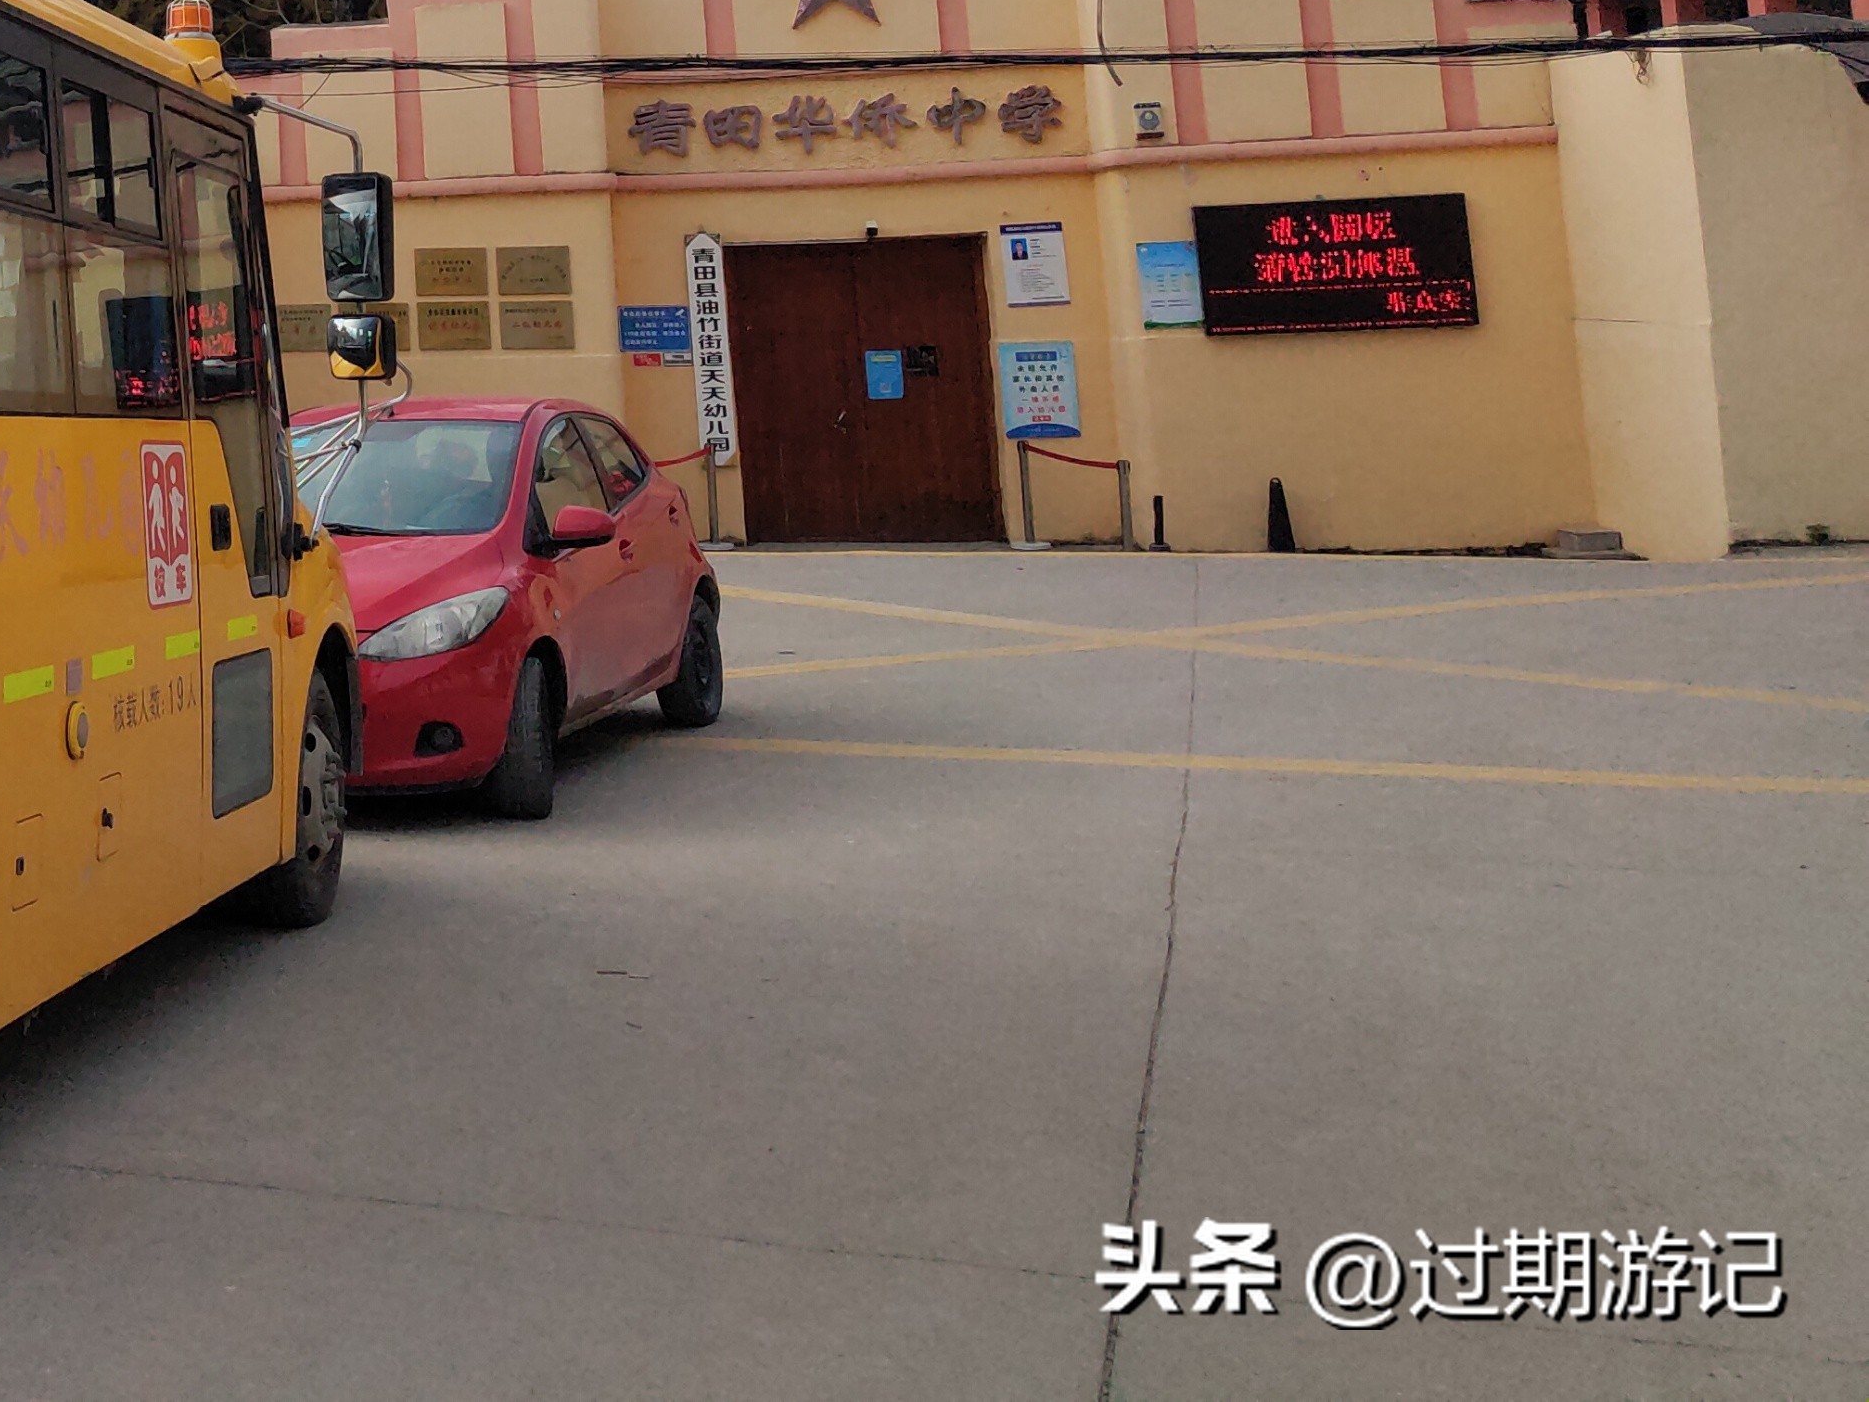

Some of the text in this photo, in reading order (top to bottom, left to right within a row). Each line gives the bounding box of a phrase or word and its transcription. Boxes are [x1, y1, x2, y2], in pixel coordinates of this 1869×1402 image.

[628, 85, 1063, 158] 青田华侨中学
[691, 248, 729, 452] 青田县油竹街道天天幼儿园
[153, 561, 187, 598] 校车
